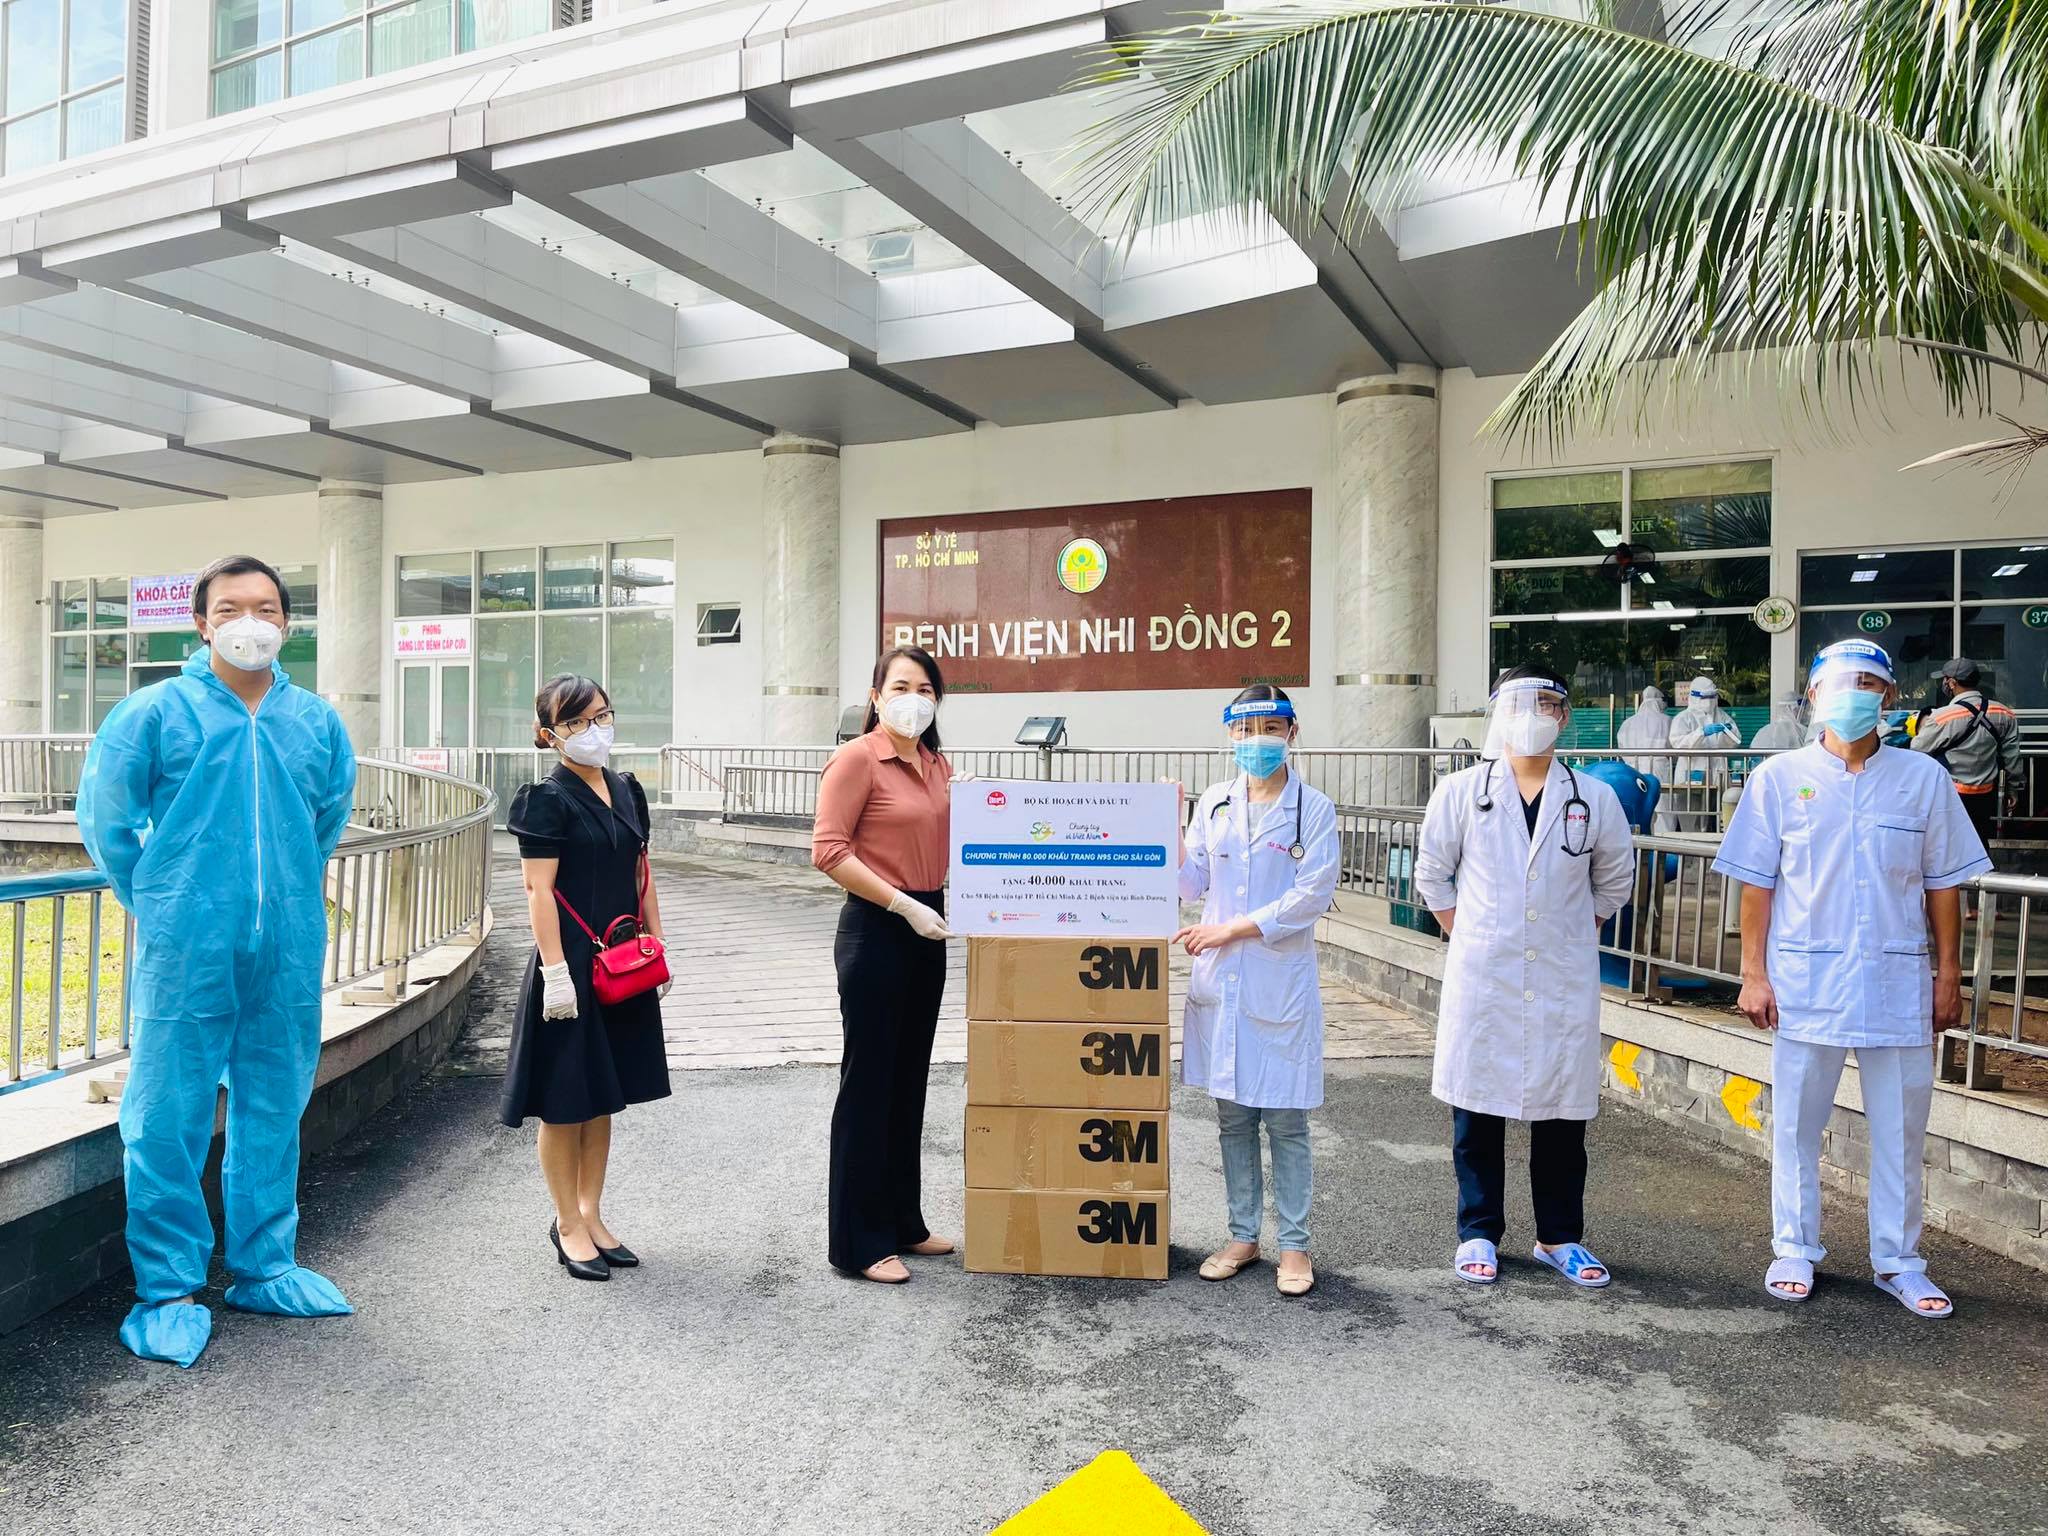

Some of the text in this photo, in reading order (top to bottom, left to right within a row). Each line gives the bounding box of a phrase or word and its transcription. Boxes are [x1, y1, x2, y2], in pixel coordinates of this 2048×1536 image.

[1630, 519, 1653, 532] XIT
[934, 535, 942, 549] Y
[895, 554, 912, 568] TP.
[934, 549, 951, 567] CHÍ
[954, 550, 979, 566] MINH
[136, 585, 168, 602] KHOA
[137, 607, 175, 617] EMERGENCY
[2031, 611, 2048, 624] 37
[1866, 616, 1884, 628] 38
[989, 617, 1068, 664] VIỆN
[1080, 617, 1135, 654] NHI
[1147, 603, 1258, 652] ĐỒNG
[1271, 610, 1292, 648] 2
[1052, 797, 1083, 806] HOẠCH
[965, 852, 997, 860] CHƯƠNG
[999, 851, 1021, 860] TRÌNH
[1113, 853, 1129, 861] CHO
[1144, 852, 1160, 861] GÒN
[1028, 874, 1066, 886] 40.000
[1078, 946, 1158, 990] 3M
[1080, 1032, 1160, 1076] 3M
[1078, 1119, 1158, 1164] 3M
[1077, 1200, 1157, 1245] 3M
